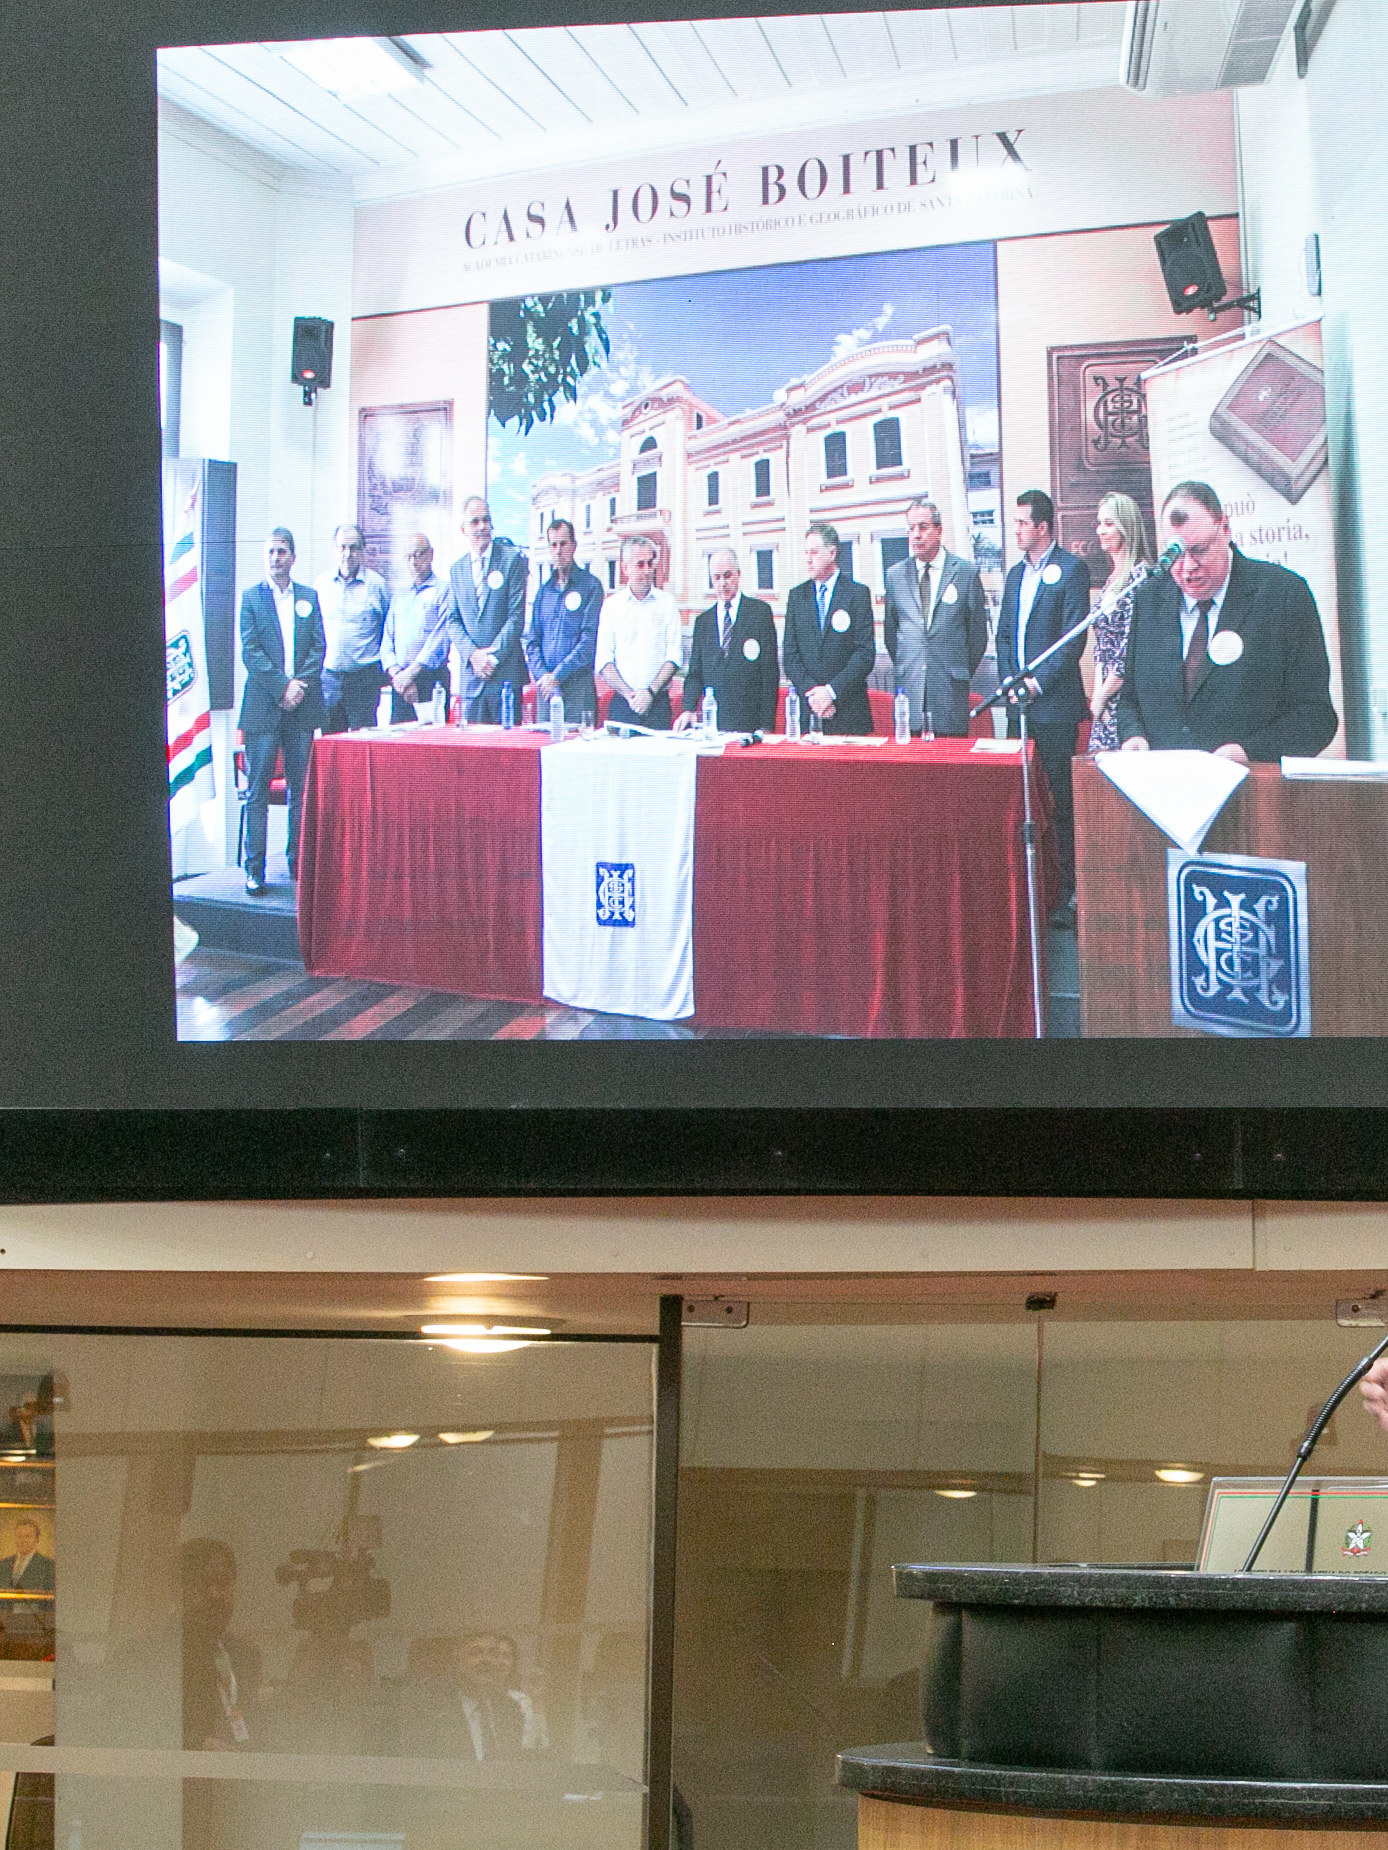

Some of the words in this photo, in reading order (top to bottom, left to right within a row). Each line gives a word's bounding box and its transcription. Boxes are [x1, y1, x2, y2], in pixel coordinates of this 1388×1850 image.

[464, 196, 578, 249] CASA
[605, 159, 729, 233] JOSÉ
[759, 129, 1032, 206] BOITEUX
[1250, 518, 1310, 546] storia,
